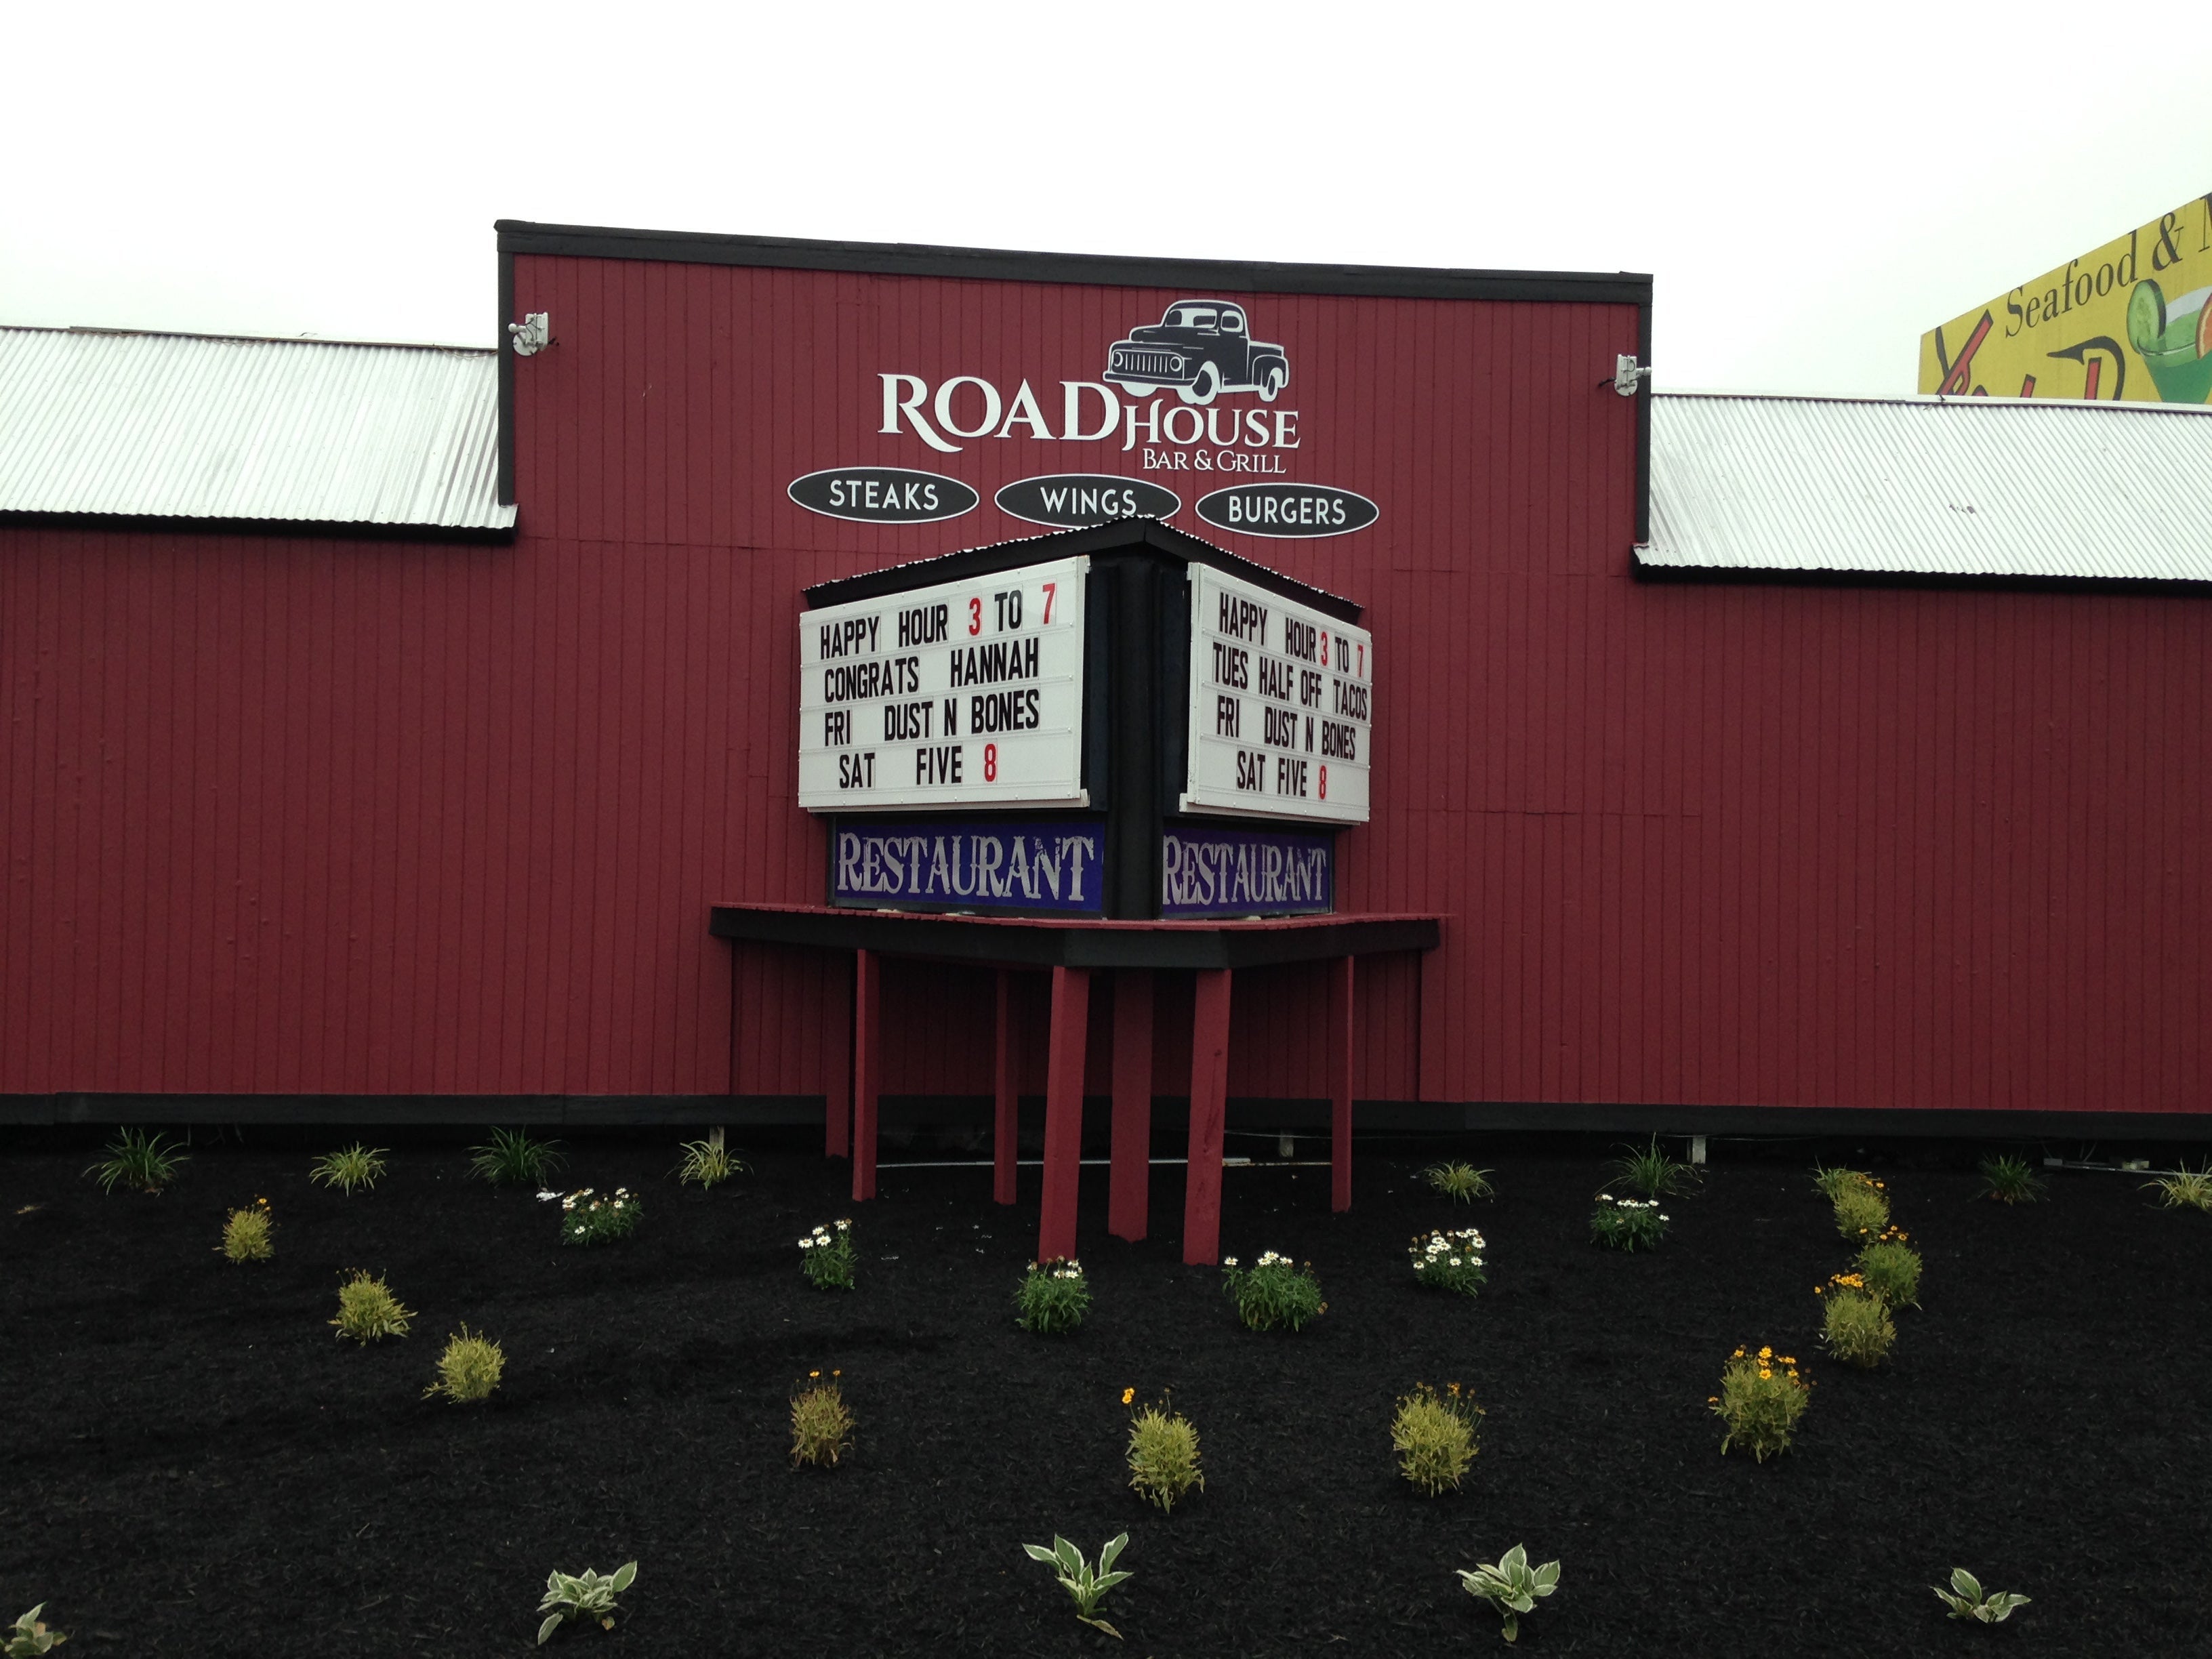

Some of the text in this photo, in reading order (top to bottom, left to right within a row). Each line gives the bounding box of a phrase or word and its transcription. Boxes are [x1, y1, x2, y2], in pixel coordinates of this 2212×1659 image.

[2005, 229, 2137, 338] Seafood
[2152, 212, 2184, 271] &
[1143, 449, 1286, 474] BAR & GRILL
[829, 480, 939, 511] STEAKS
[1040, 487, 1137, 516] WINGS
[1229, 496, 1346, 525] BURGERS
[821, 583, 1056, 660] HAPPY HOUR 3 TO 7
[1220, 592, 1364, 677] HAPPY HOUR 3 TO 7
[825, 637, 1039, 703] CONGRATS HANNAH
[1213, 642, 1367, 720] TUES HALF OFF TACOS
[825, 689, 1039, 746] FRI DUST N BONES
[1217, 695, 1355, 760] FRI DUST N BONES
[839, 743, 997, 789] SAT FIVE 8
[1237, 751, 1326, 800] SAT FIVE 8
[837, 833, 1094, 901] RESTAURANT
[1163, 834, 1326, 905] RESTAURANT
